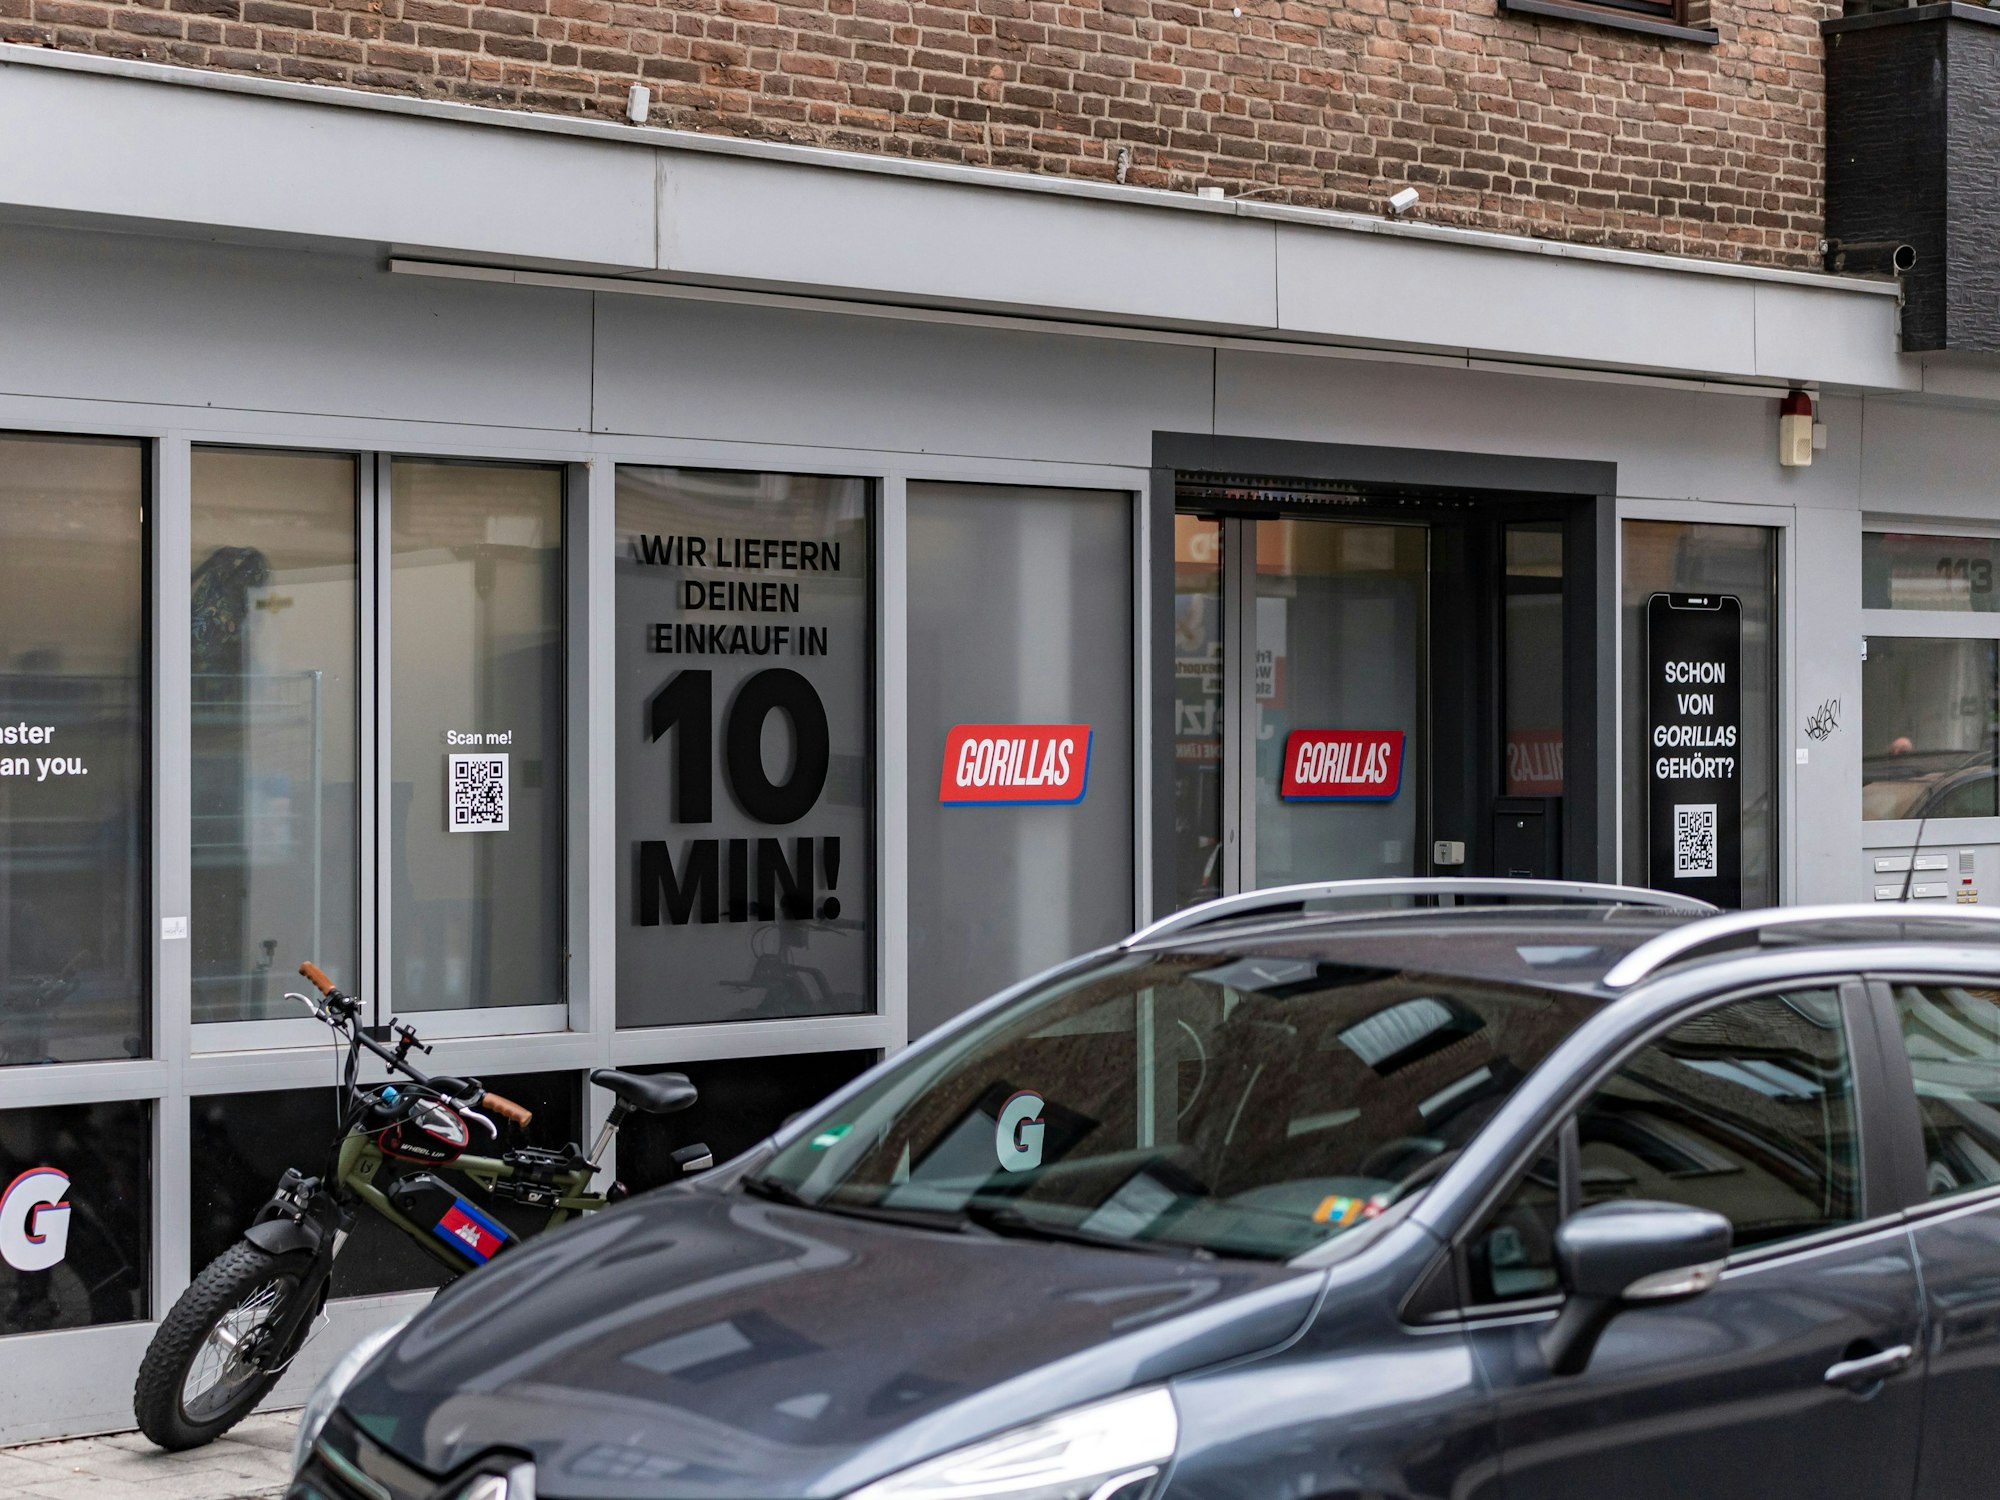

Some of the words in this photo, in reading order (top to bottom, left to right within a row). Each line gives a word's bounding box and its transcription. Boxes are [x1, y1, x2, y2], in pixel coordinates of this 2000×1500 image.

[640, 534, 707, 567] WIR
[717, 537, 841, 571] LIEFERN
[1935, 556, 1993, 594] 113
[684, 579, 799, 613] DEINEN
[655, 623, 790, 656] EINKAUF
[799, 626, 828, 656] IN
[1665, 661, 1726, 684] SCHON
[1677, 693, 1714, 715] VON
[446, 729, 483, 745] Scan
[486, 729, 513, 745] me!
[652, 667, 830, 825] 10
[1653, 725, 1737, 747] GORILLAS
[36, 757, 88, 782] you.
[956, 738, 1074, 787] GORILLAS
[1295, 741, 1391, 784] GORILLAS
[1655, 752, 1735, 779] GEHÖRT?
[640, 836, 841, 927] MIN!
[995, 1089, 1045, 1173] G
[0, 1166, 71, 1271] G
